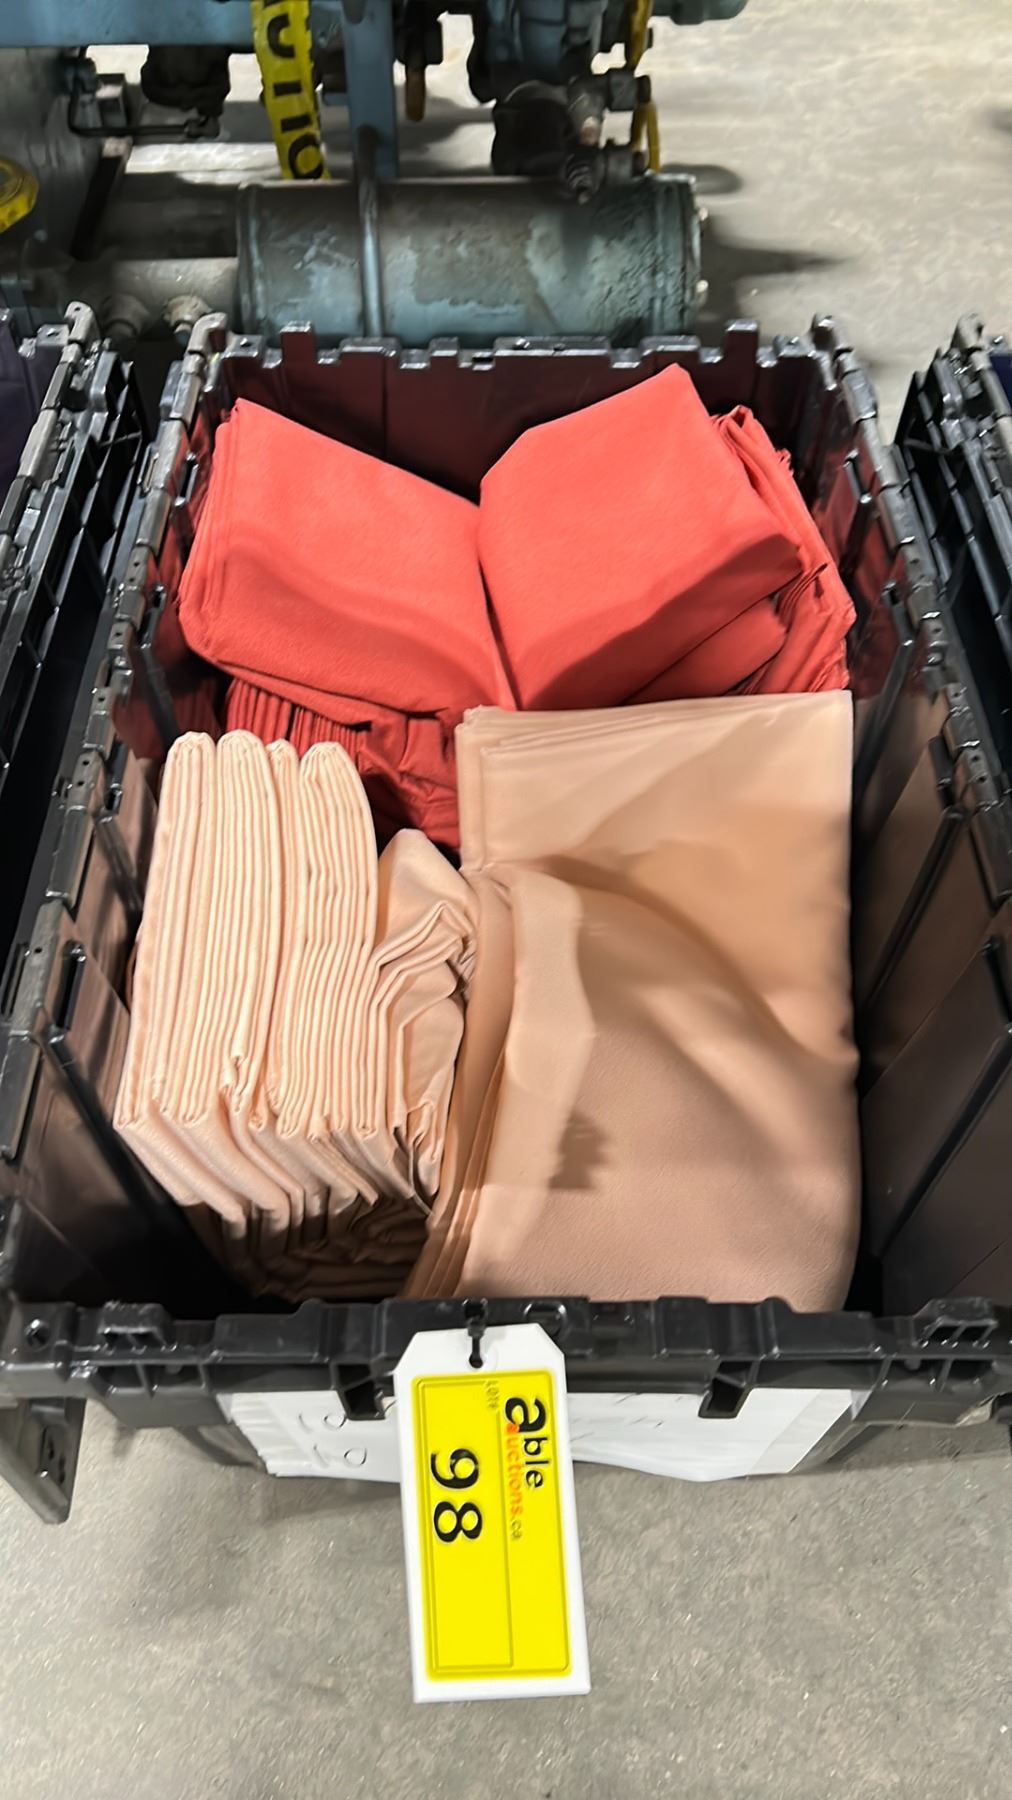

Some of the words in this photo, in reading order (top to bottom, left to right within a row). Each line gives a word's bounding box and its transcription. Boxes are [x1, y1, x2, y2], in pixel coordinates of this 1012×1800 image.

[505, 1397, 550, 1489] able
[506, 1423, 524, 1541] auctions.ca
[430, 1448, 483, 1543] 98
